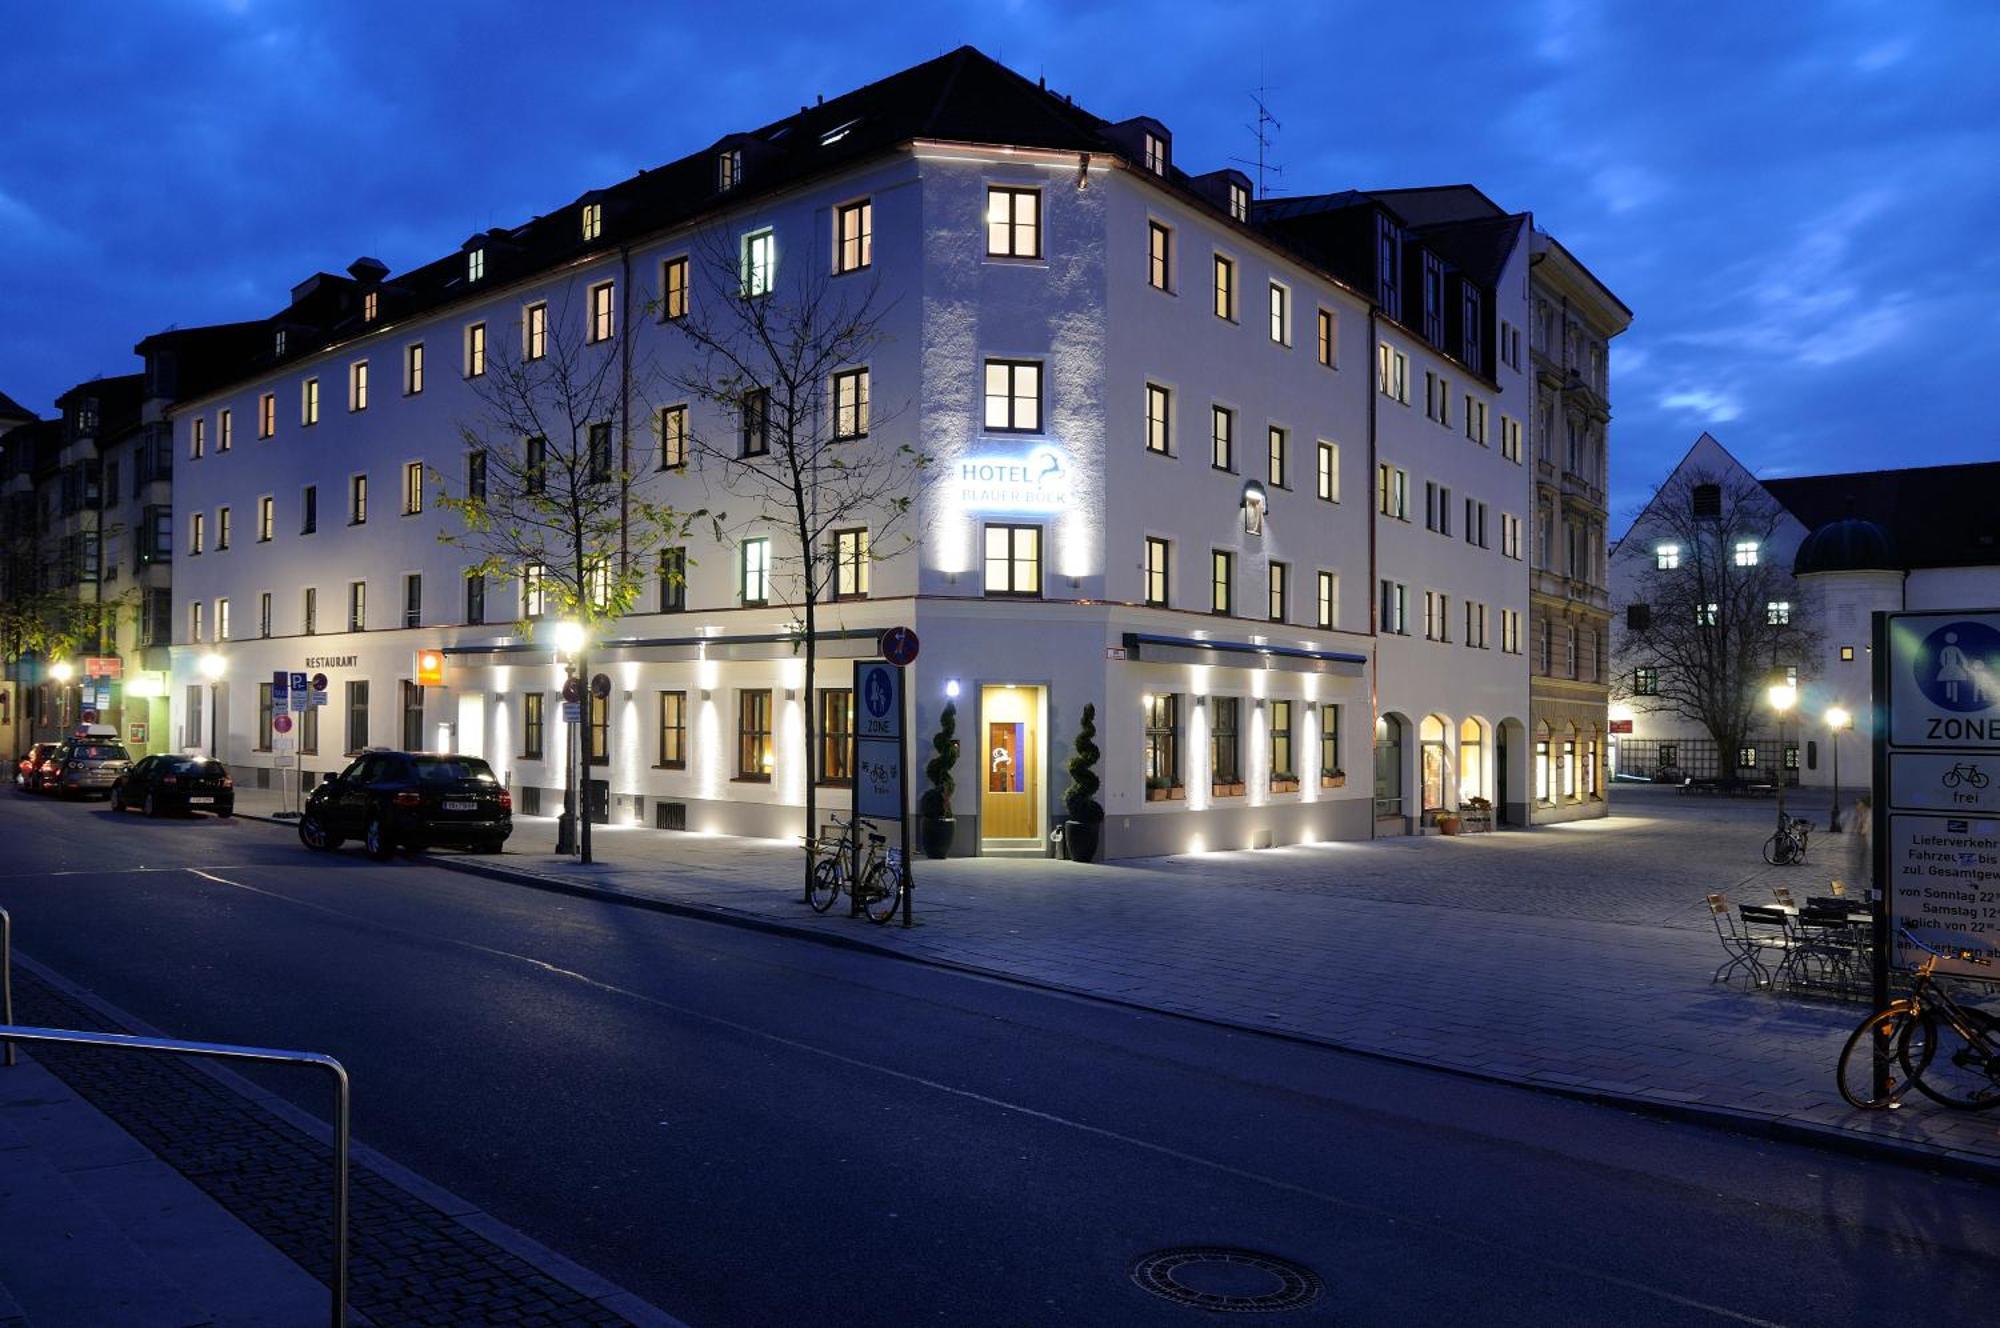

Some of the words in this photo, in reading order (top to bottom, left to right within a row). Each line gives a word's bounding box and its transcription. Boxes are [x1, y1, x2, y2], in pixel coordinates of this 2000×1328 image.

[962, 464, 1033, 482] HOTEL
[962, 488, 1020, 502] BLAUER
[1026, 490, 1065, 504] BOCK
[306, 656, 358, 668] RESTAURANT
[293, 675, 302, 689] P
[868, 719, 890, 733] ZONE
[1927, 718, 2000, 740] ZONE
[1953, 791, 1979, 803] frei
[1912, 834, 1998, 849] Lieferverkehr
[1978, 853, 1998, 865] bis
[1899, 887, 1920, 897] von
[1923, 887, 1976, 903] Sonntag
[1921, 903, 1977, 919] Samstag
[1945, 922, 1967, 931] von
